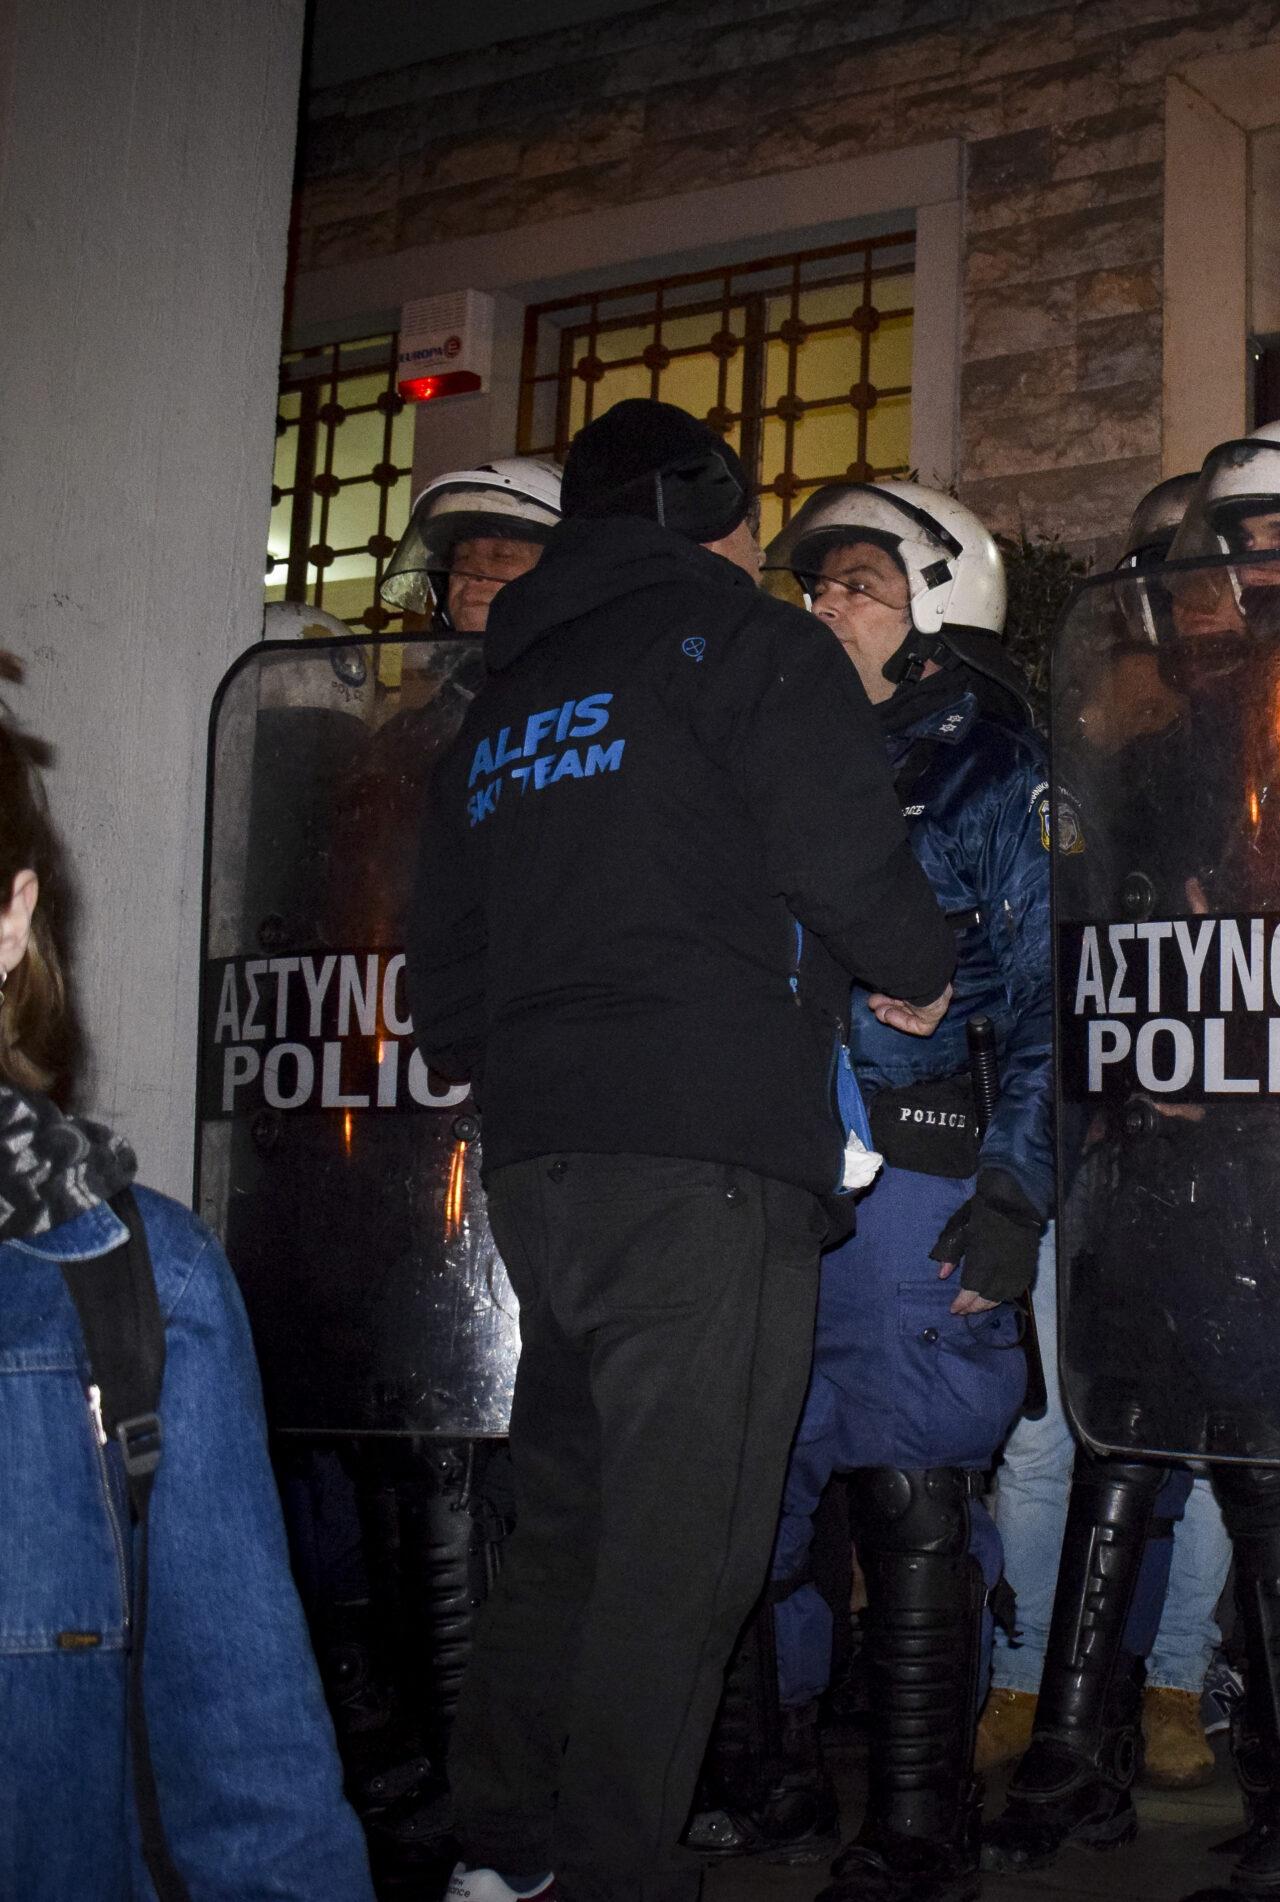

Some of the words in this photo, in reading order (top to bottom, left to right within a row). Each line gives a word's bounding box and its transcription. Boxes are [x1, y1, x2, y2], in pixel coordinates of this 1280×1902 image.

[467, 692, 615, 789] ALFIS
[511, 738, 626, 796] TEAM
[213, 953, 415, 1043] ΑΣΤΥΝΟ
[222, 1040, 472, 1111] POLIC
[900, 1107, 966, 1128] POLICE
